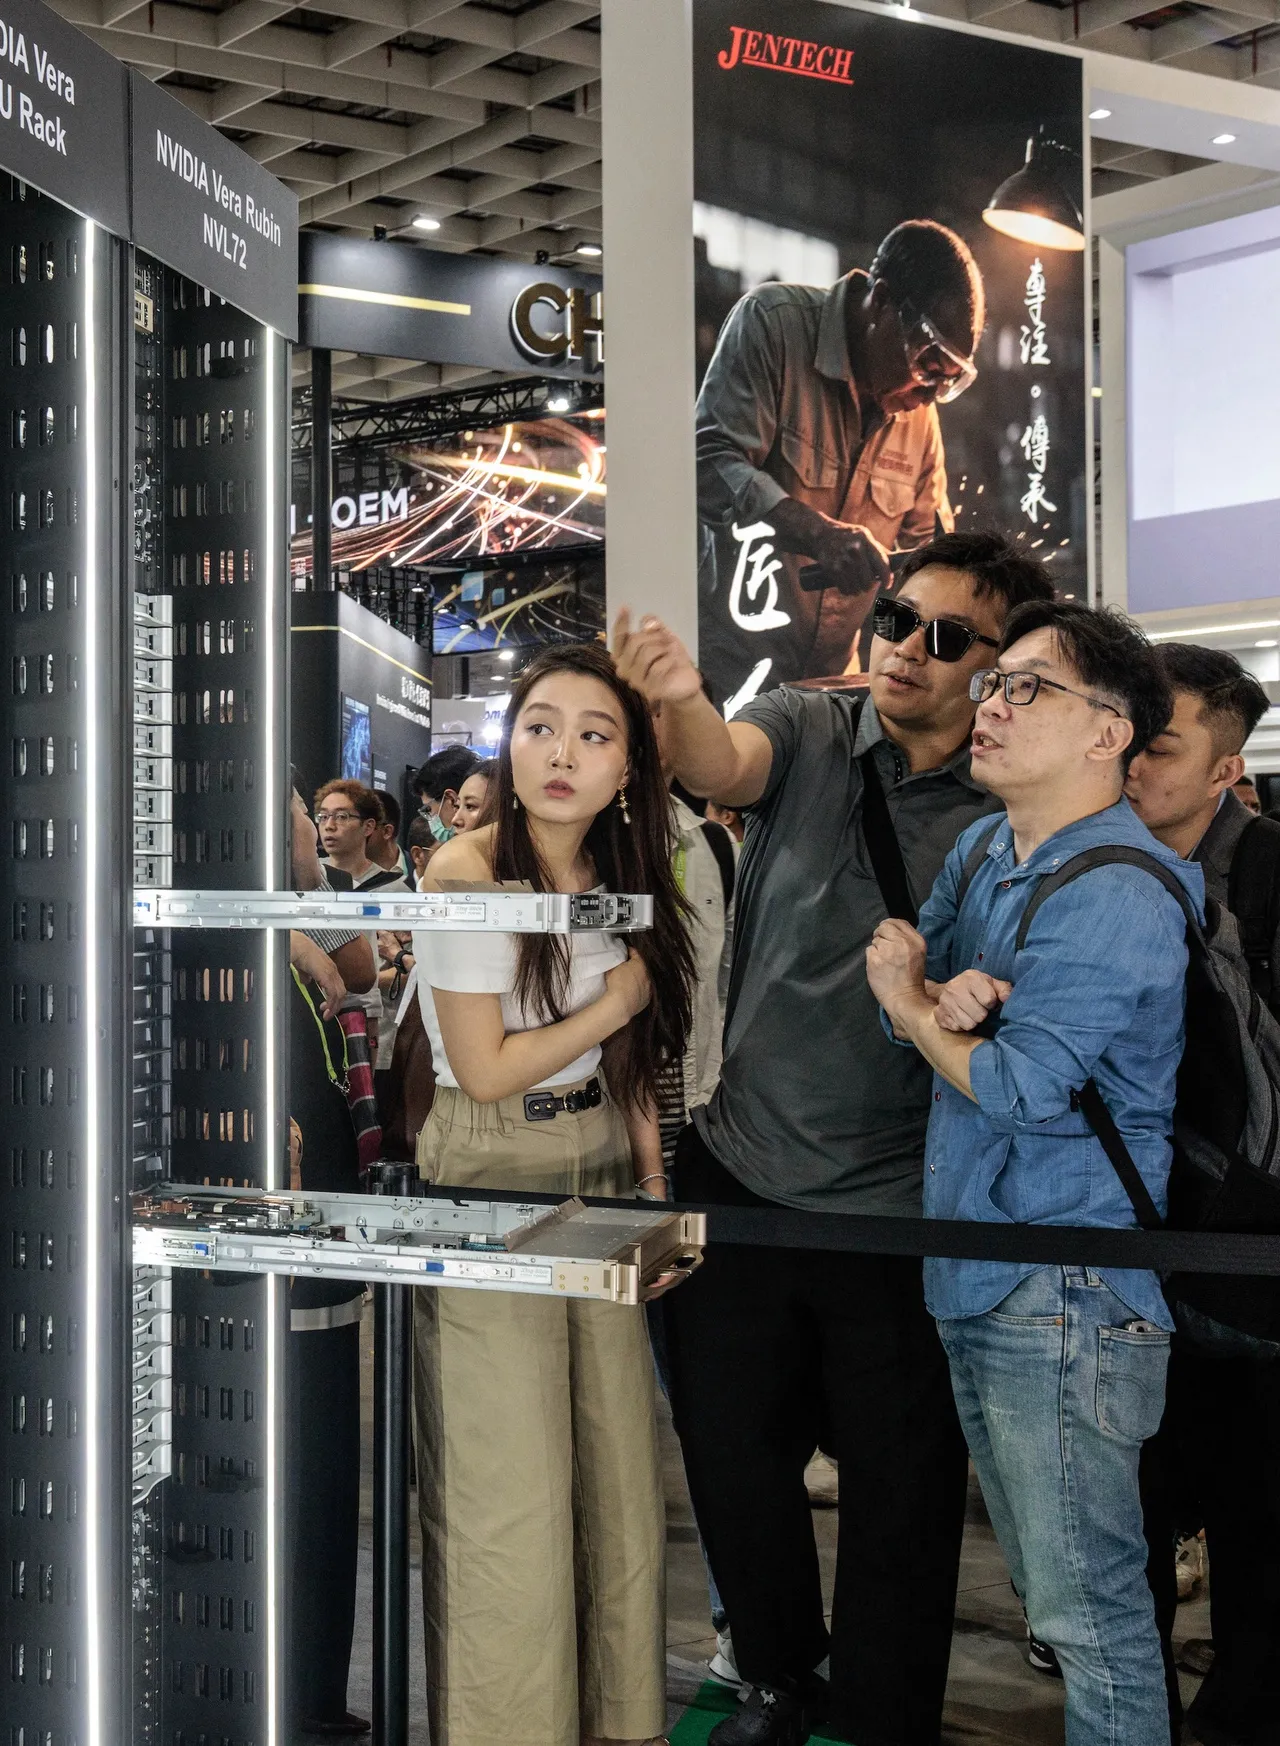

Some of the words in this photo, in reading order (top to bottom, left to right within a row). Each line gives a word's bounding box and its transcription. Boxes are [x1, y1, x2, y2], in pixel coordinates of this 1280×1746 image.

[33, 43, 75, 106] Vera
[717, 26, 855, 80] JENTECH
[19, 92, 67, 156] Rack
[156, 129, 209, 196] NVIDIA
[212, 169, 242, 219] Vera
[245, 194, 281, 247] Rubin
[203, 213, 247, 270] NVL72
[331, 487, 408, 529] OEM
